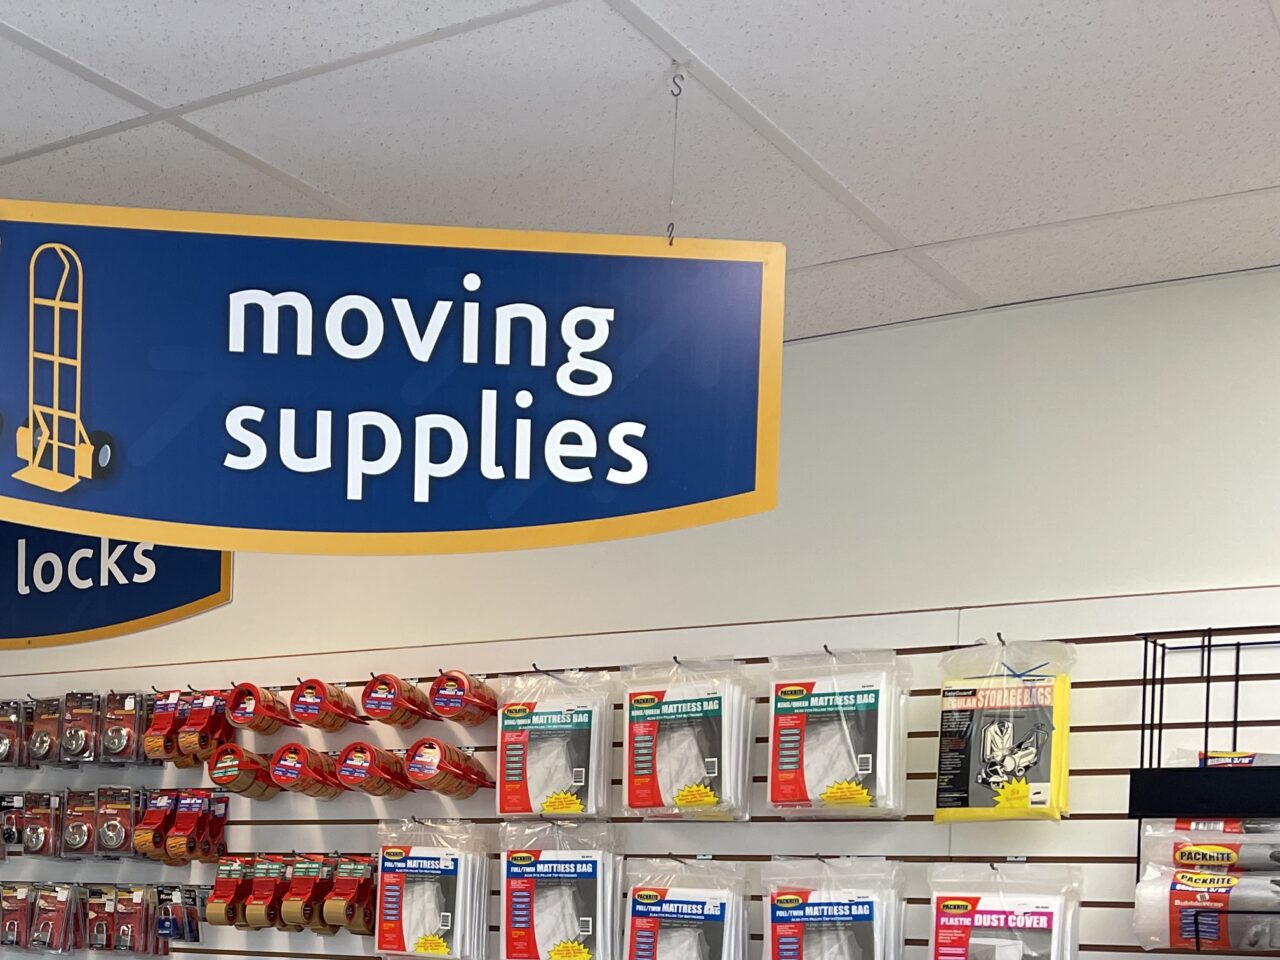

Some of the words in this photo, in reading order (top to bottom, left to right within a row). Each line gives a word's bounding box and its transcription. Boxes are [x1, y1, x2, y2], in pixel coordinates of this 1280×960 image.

[228, 272, 615, 398] moving
[223, 391, 649, 503] supplies
[17, 536, 157, 595] locks
[810, 695, 855, 706] MATTRESS
[856, 693, 875, 704] BAG
[977, 688, 1023, 708] STORAGE
[1024, 687, 1052, 706] BAGS
[661, 702, 702, 714] MATTRESS
[702, 700, 719, 711] BAG
[532, 714, 571, 724] MATTRESS
[572, 713, 588, 722] BAG
[1180, 851, 1232, 861] PACKRITE
[406, 859, 440, 869] MATTRESS
[536, 863, 575, 872] MATTRESS
[576, 863, 593, 873] BAG
[1180, 874, 1233, 884] PACKRITE
[662, 903, 702, 914] MATTRESS
[805, 906, 850, 916] MATTRESS
[851, 905, 870, 915] BAG
[940, 917, 972, 926] PLASTIC
[974, 914, 1006, 927] DUST
[1008, 915, 1048, 928] COVER
